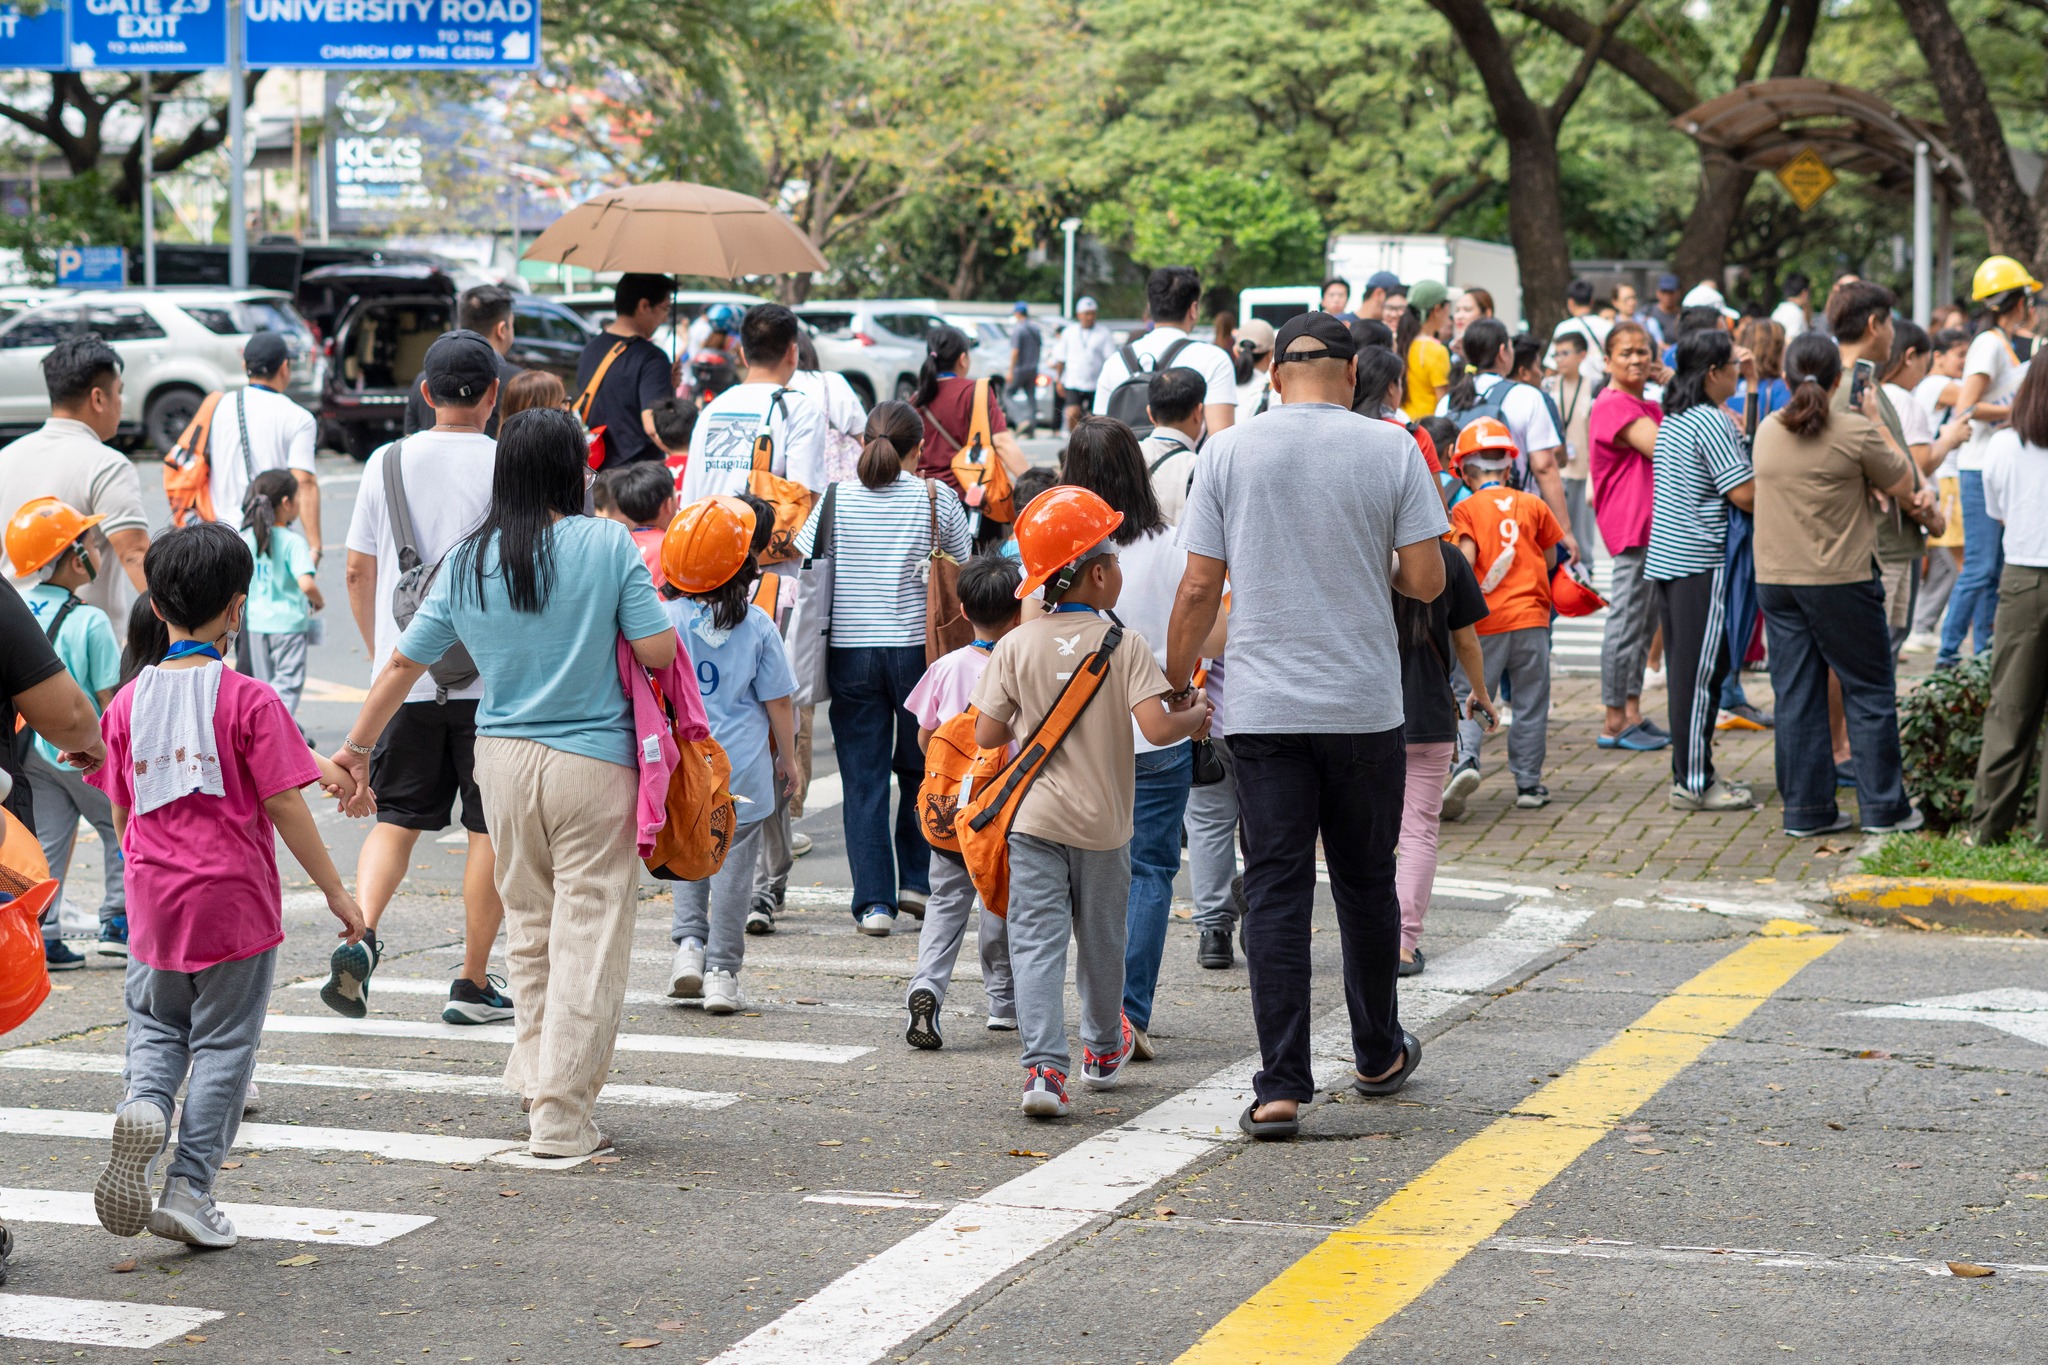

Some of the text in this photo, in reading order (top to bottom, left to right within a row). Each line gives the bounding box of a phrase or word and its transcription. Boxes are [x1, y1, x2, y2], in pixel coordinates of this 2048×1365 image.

[246, 0, 532, 22] UNIVERSITY ROAD
[117, 14, 181, 38] EXIT
[437, 29, 494, 43] TO THE
[320, 44, 495, 59] CHURCH OF THE GESU
[335, 136, 423, 168] KICKS
[58, 249, 82, 278] P
[1498, 518, 1519, 548] 9
[697, 660, 720, 696] 9
